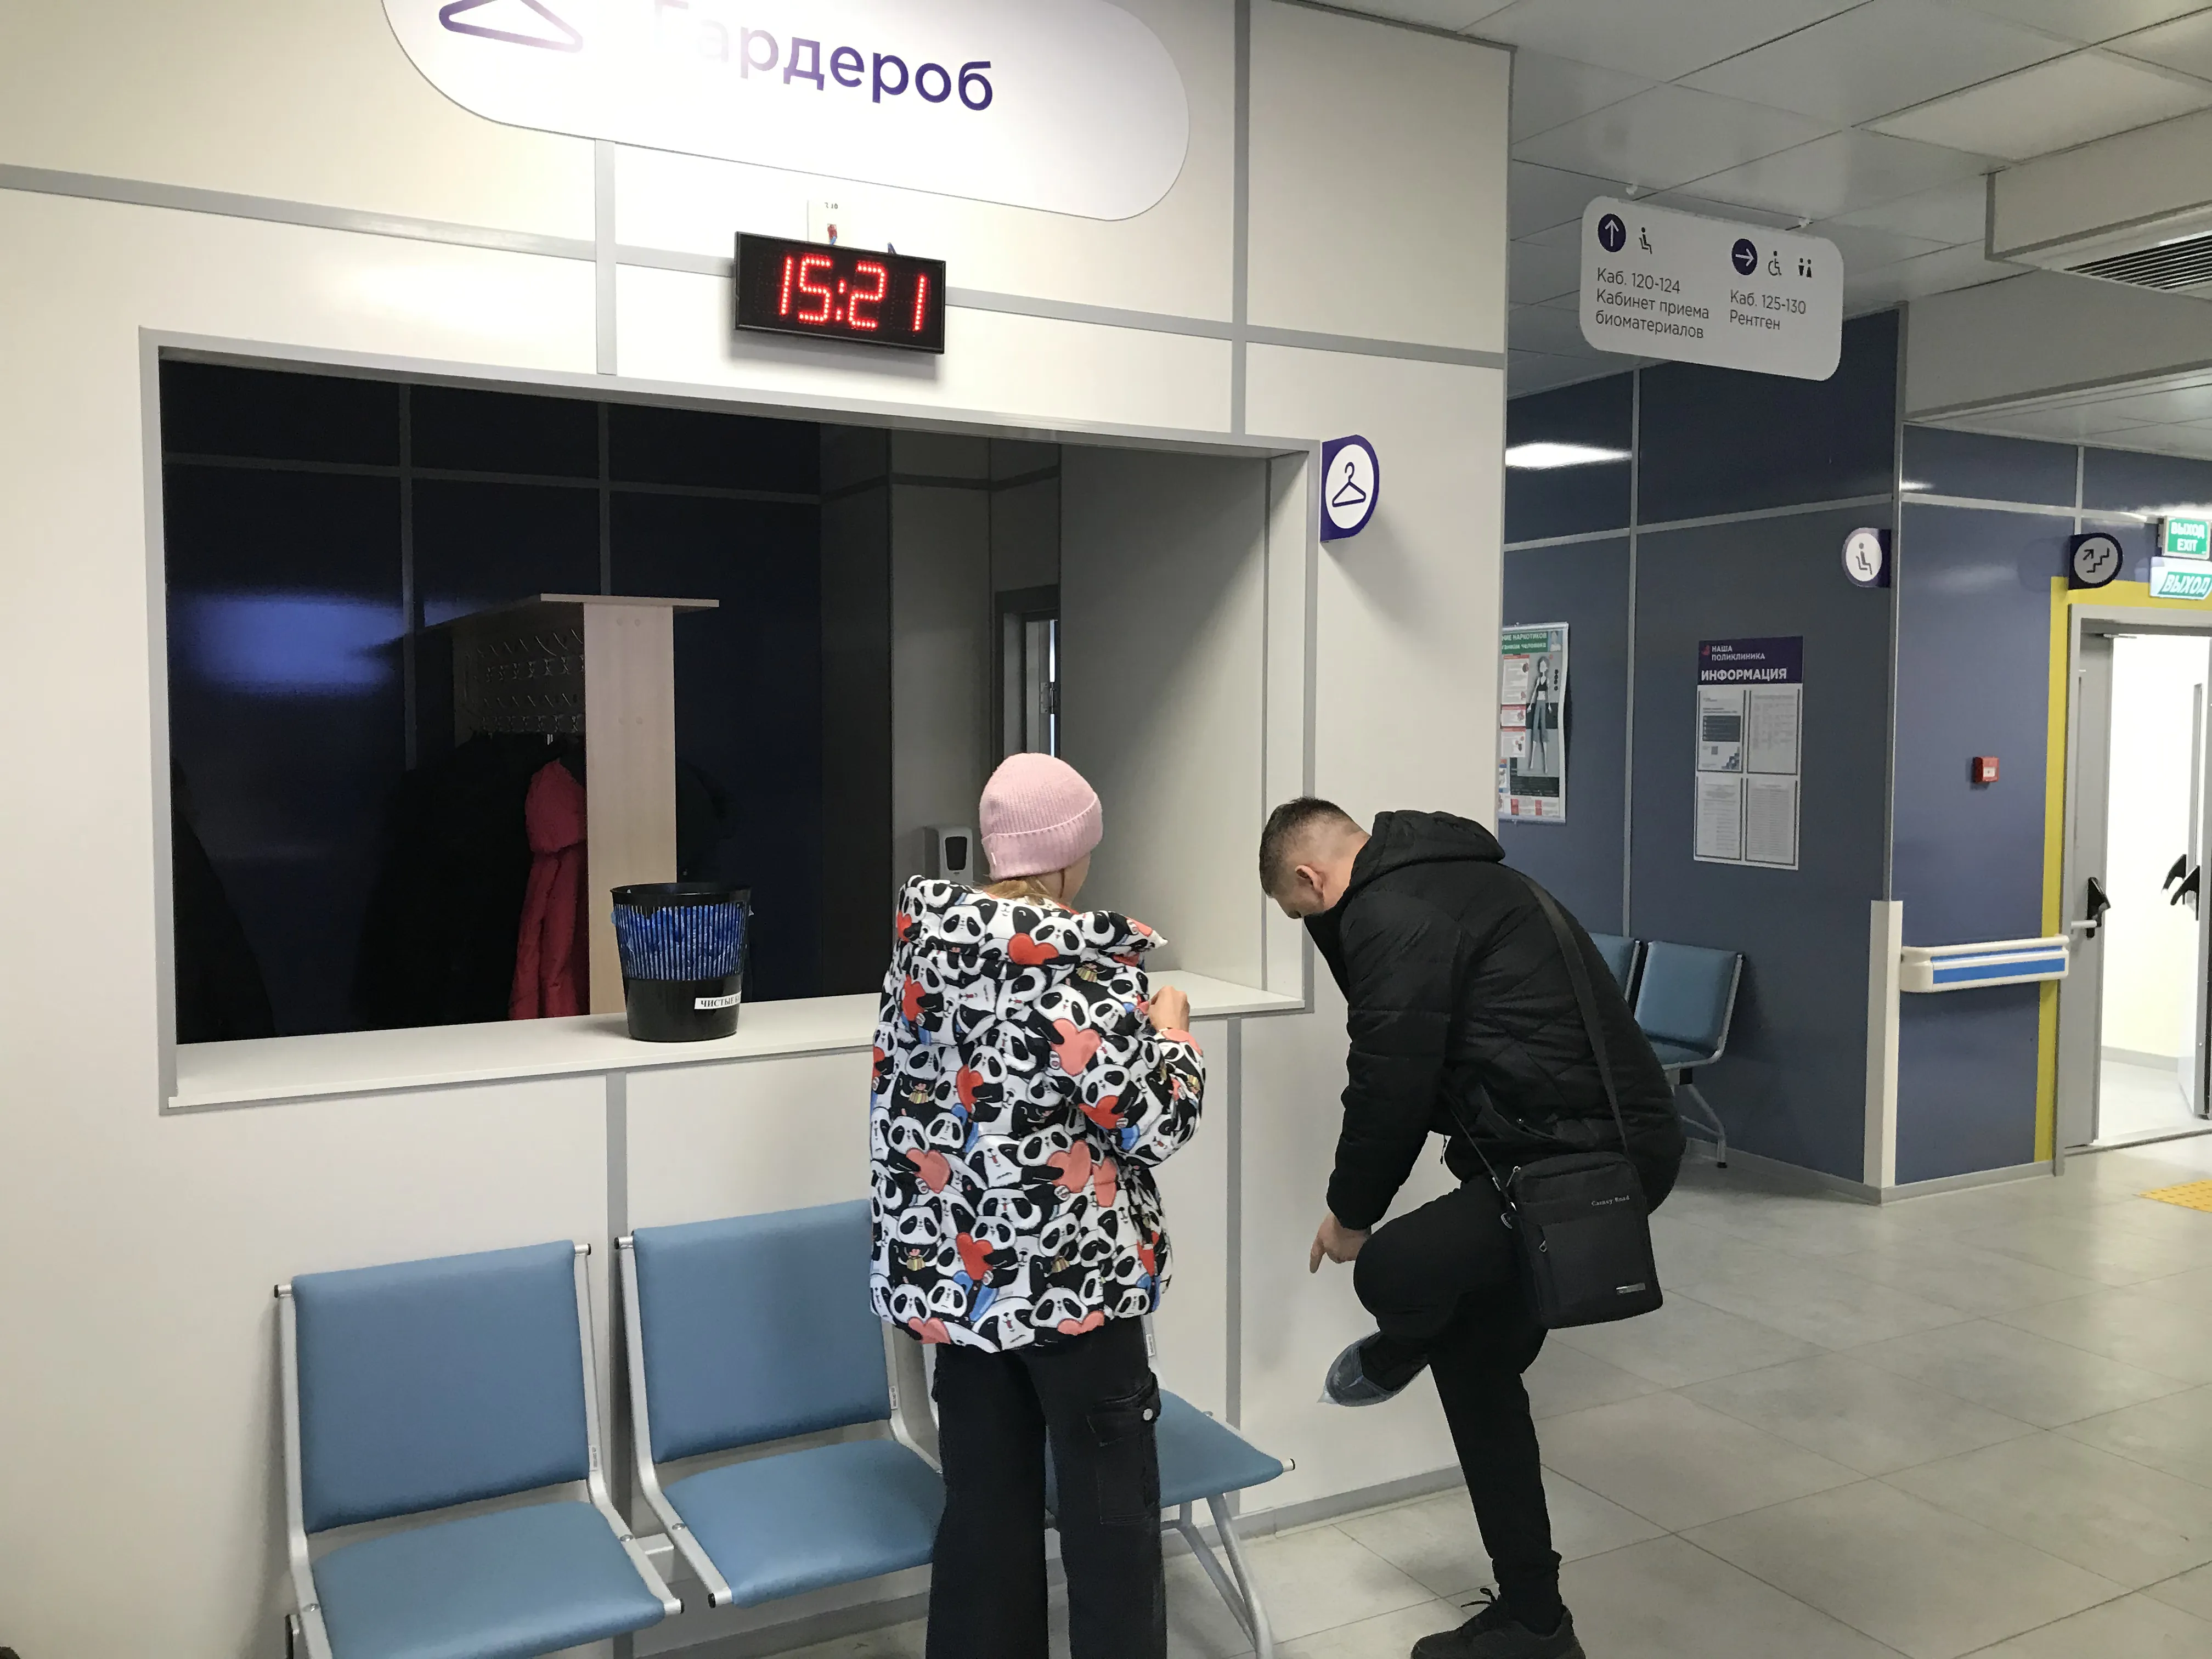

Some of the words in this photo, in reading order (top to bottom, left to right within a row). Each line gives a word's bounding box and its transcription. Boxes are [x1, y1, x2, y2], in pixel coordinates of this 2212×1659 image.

[1598, 267, 1627, 286] Каб.
[1632, 272, 1680, 294] 120-124
[779, 254, 931, 333] 15:21
[1596, 288, 1655, 311] Кабинет
[1660, 301, 1709, 319] приема
[1730, 289, 1757, 307] Каб.
[1762, 294, 1807, 315] 125-130
[1595, 311, 1704, 339] биоматериалов
[1730, 309, 1780, 330] Рентген
[2171, 522, 2205, 539] ВЫХОД
[2177, 538, 2198, 552] EXIT
[2161, 574, 2211, 595] ВЫХОД
[1513, 632, 1547, 640] НАРКОТИКОВ
[1711, 653, 1765, 661] ПОЛИКЛИНИКА
[1701, 668, 1787, 681] ИНФОРМАЦИЯ
[701, 997, 735, 1007] ЧИСТЫЕ
